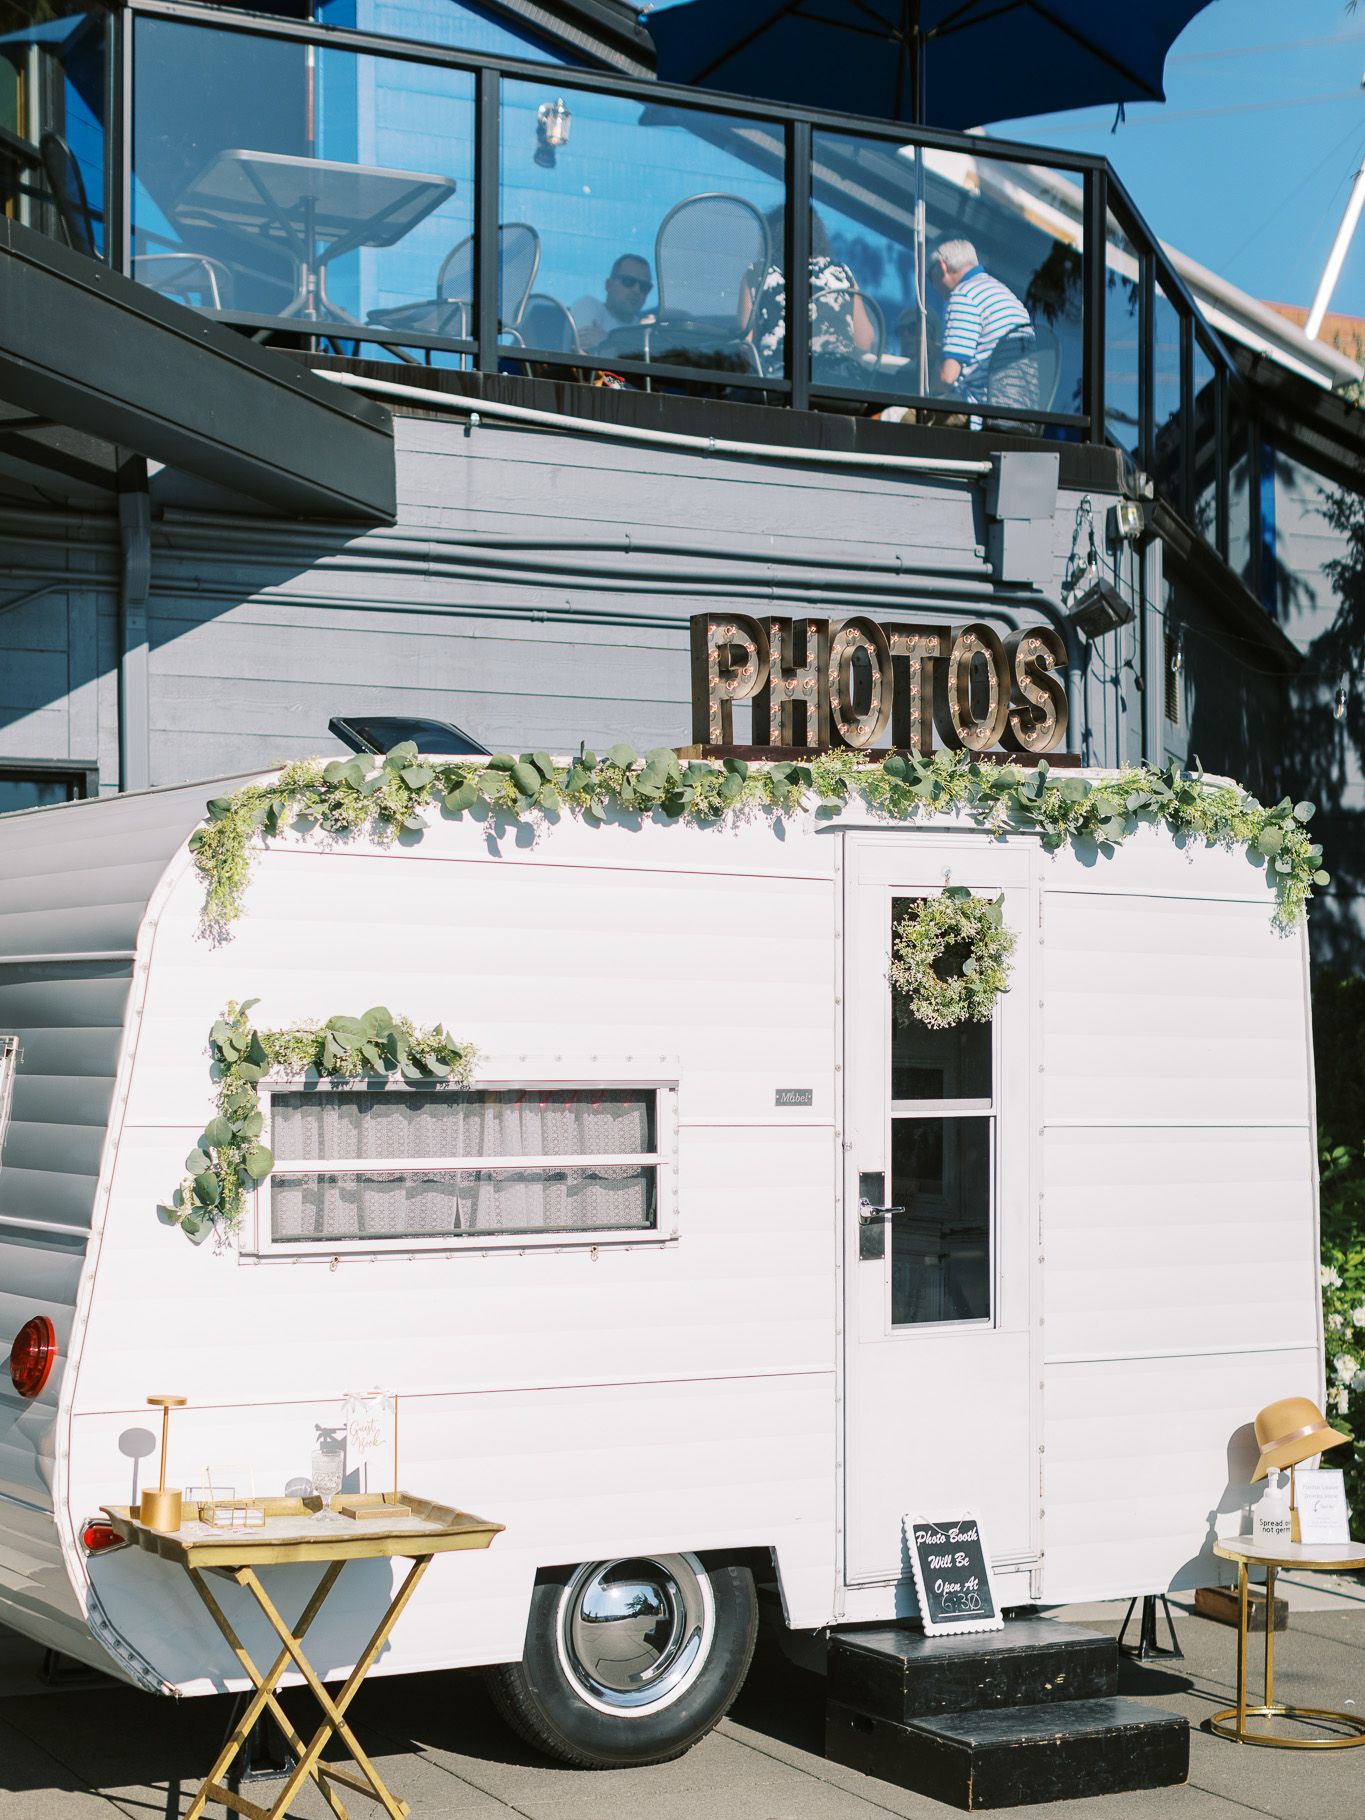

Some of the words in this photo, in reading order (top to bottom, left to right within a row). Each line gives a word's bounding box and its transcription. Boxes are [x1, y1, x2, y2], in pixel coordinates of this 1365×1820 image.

[690, 613, 1068, 752] PHOTOS
[780, 1091, 809, 1103] Mabel
[349, 1417, 376, 1445] Guest
[357, 1429, 387, 1454] Book
[1259, 1518, 1283, 1527] Spread
[1275, 1527, 1291, 1535] germ
[915, 1530, 946, 1547] Photo
[948, 1526, 978, 1543] Booth
[928, 1554, 953, 1569] Will
[954, 1552, 970, 1567] Be
[934, 1578, 962, 1596] Open
[963, 1576, 979, 1591] At
[941, 1591, 982, 1611] 6:30
